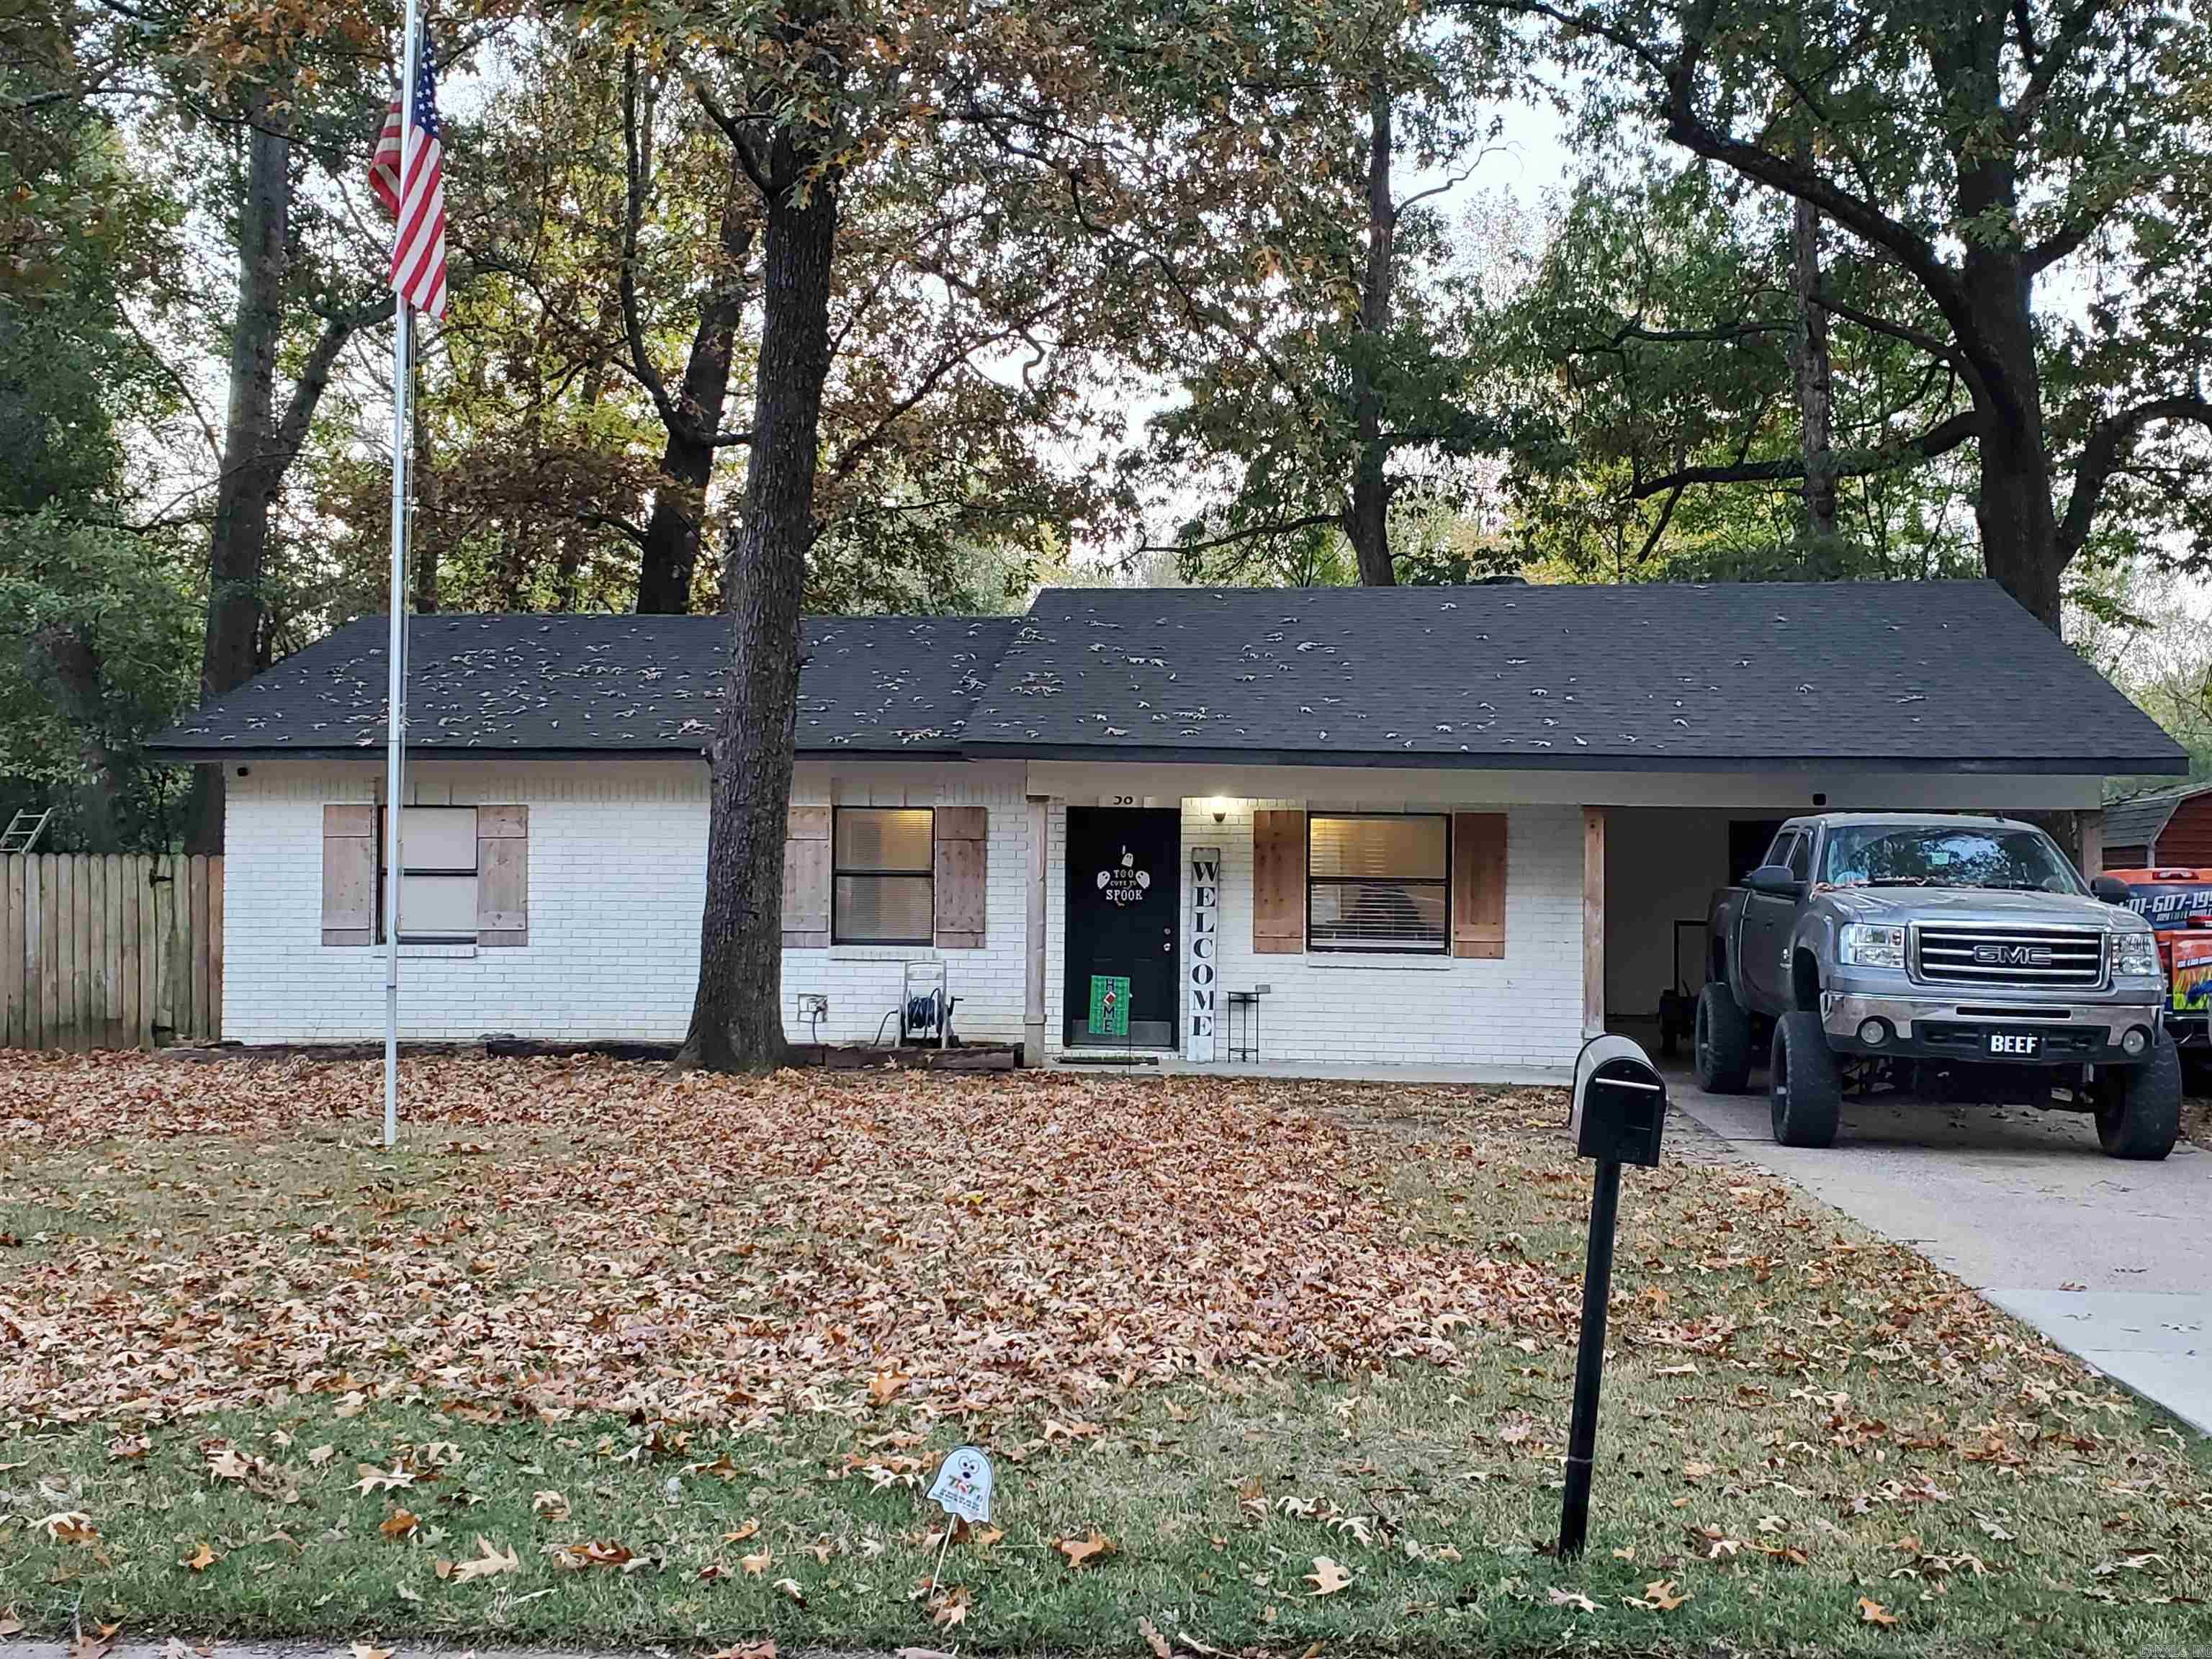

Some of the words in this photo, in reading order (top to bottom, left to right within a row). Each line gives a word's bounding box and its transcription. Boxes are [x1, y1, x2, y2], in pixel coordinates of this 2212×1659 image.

[1105, 889, 1143, 901] SPOOK
[1192, 861, 1219, 1037] WELCOME
[1973, 945, 2051, 965] GMC
[1103, 979, 1116, 1032] HME
[1990, 1035, 2038, 1053] BEEF
